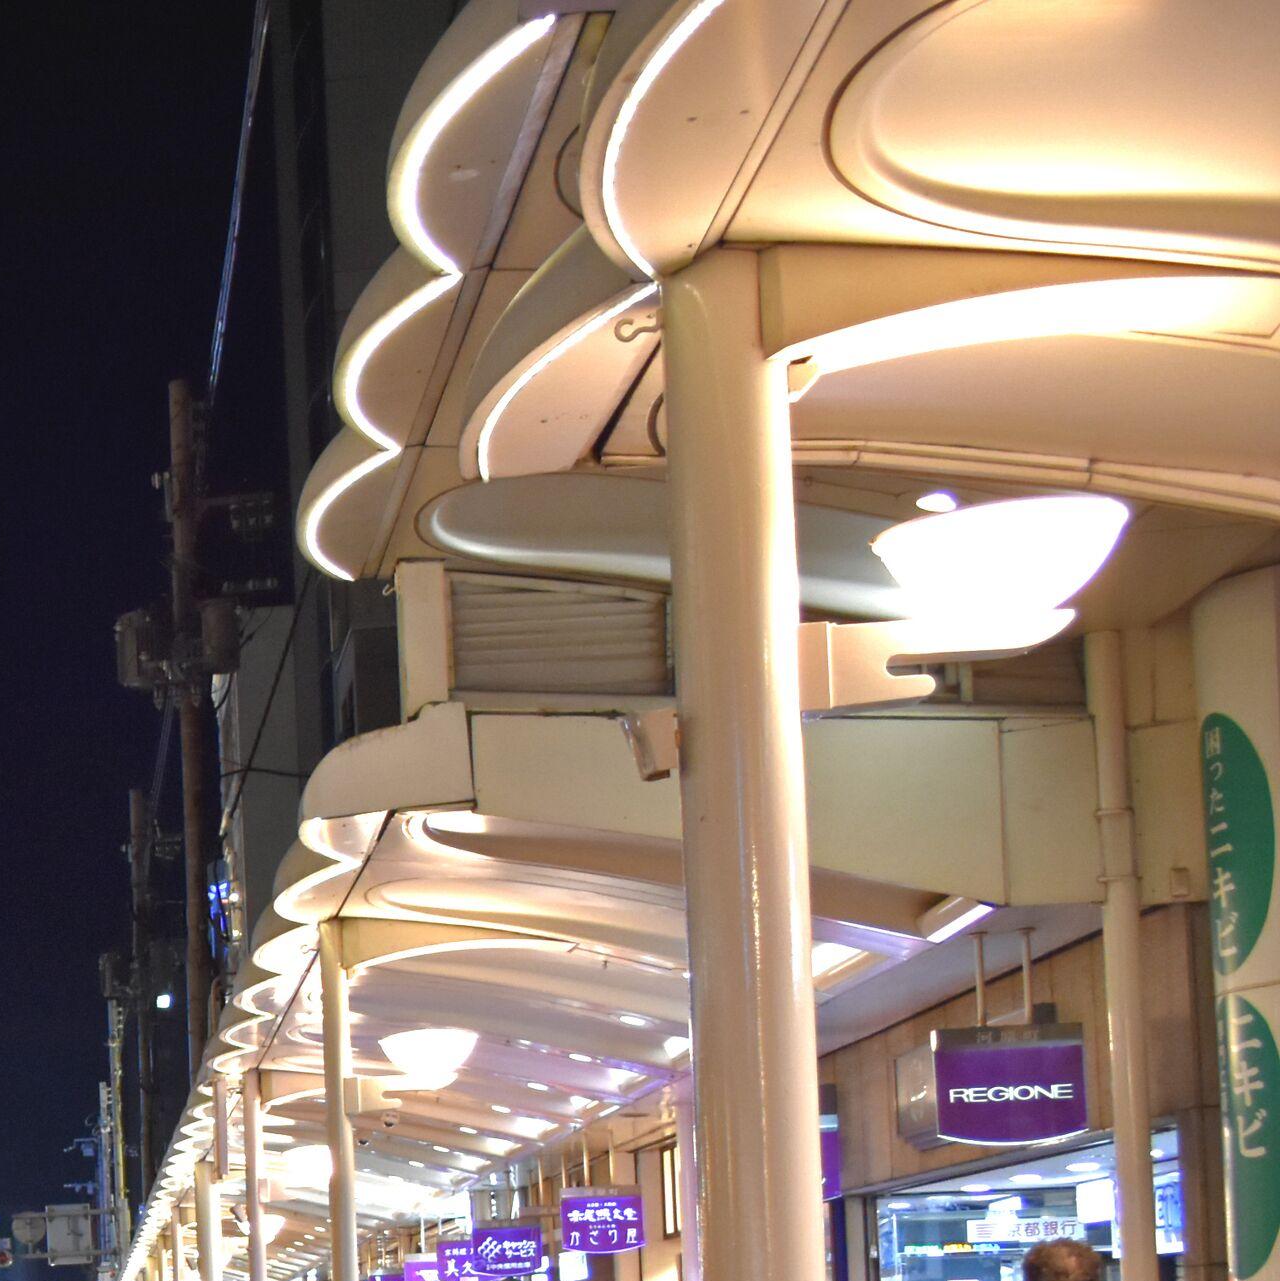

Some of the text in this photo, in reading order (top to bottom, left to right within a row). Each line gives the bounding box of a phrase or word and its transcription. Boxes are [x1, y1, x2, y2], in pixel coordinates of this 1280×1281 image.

[949, 1083, 1074, 1103] REGIONE
[1231, 1013, 1267, 1158] ニキビ
